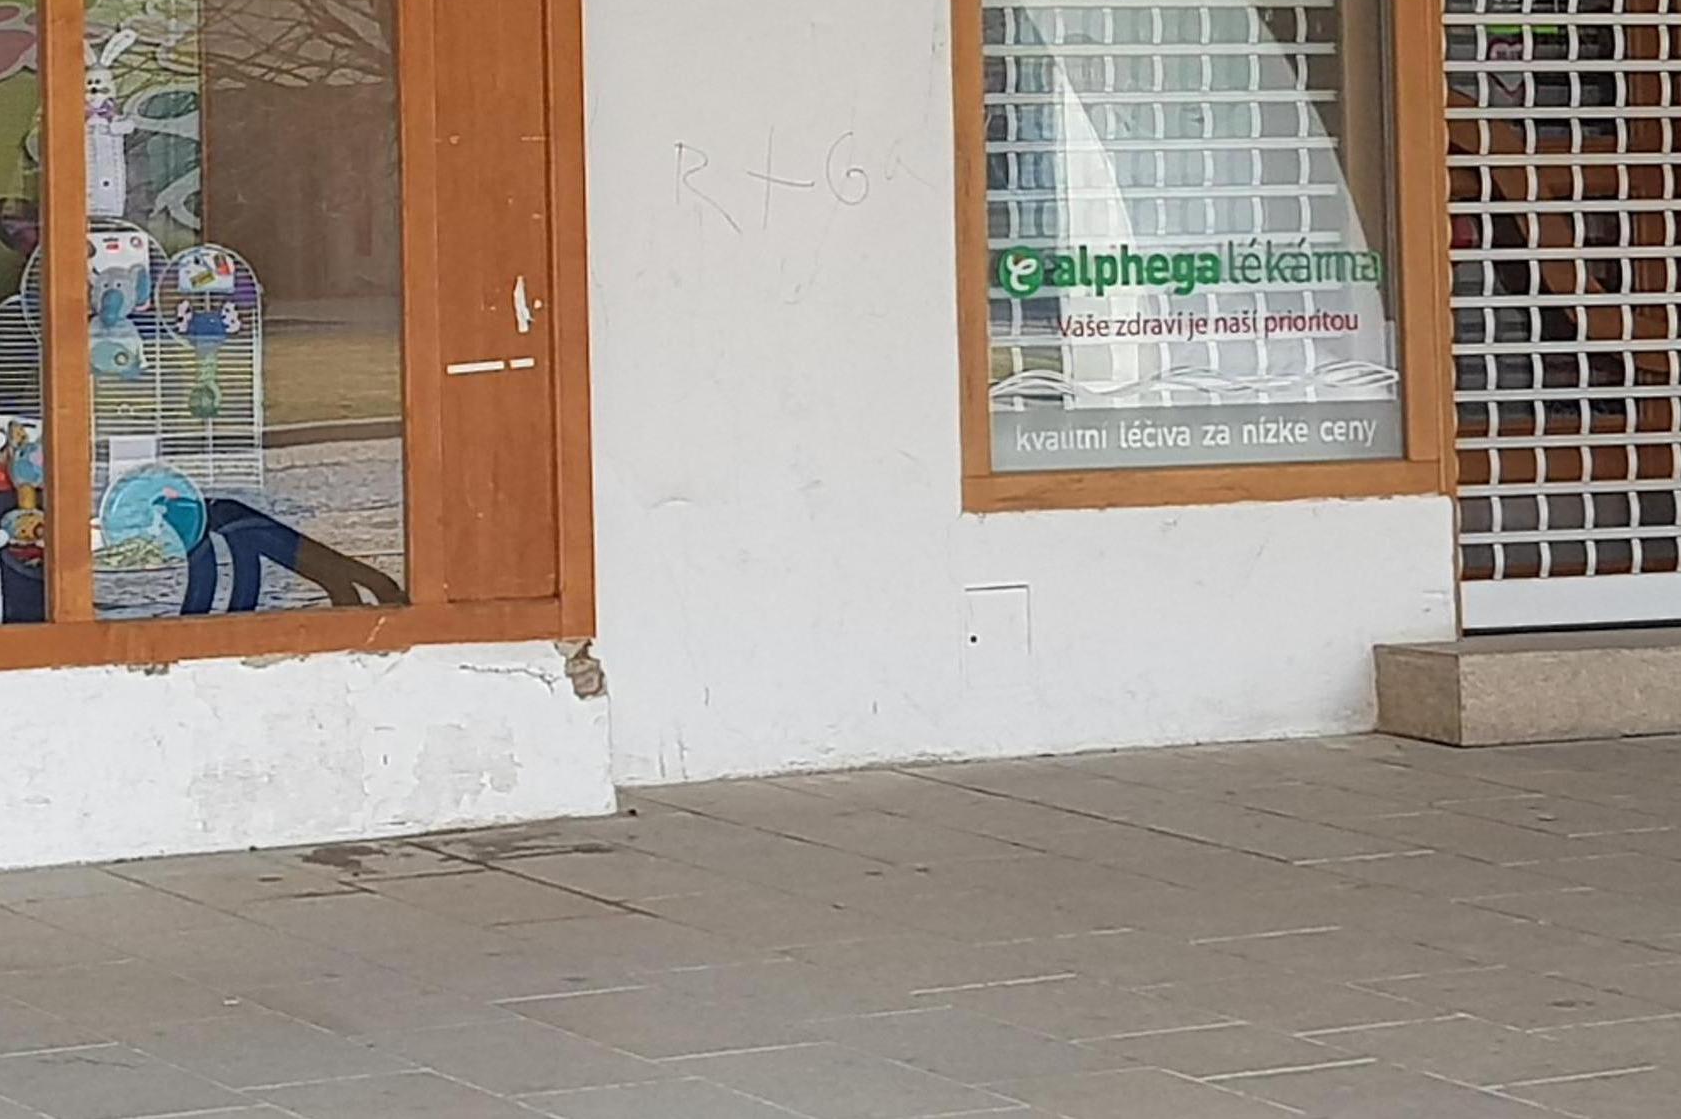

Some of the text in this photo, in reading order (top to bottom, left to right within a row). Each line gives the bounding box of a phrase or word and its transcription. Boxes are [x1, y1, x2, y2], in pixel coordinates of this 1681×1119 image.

[1053, 237, 1382, 296] alphega lékárna
[1057, 314, 1109, 338] Vaše
[1188, 312, 1208, 341] je
[1265, 309, 1358, 339] prioritou
[1016, 422, 1108, 452] kvalitní
[1119, 419, 1191, 449] léčiva
[1202, 424, 1231, 446] za
[1320, 419, 1376, 447] ceny
